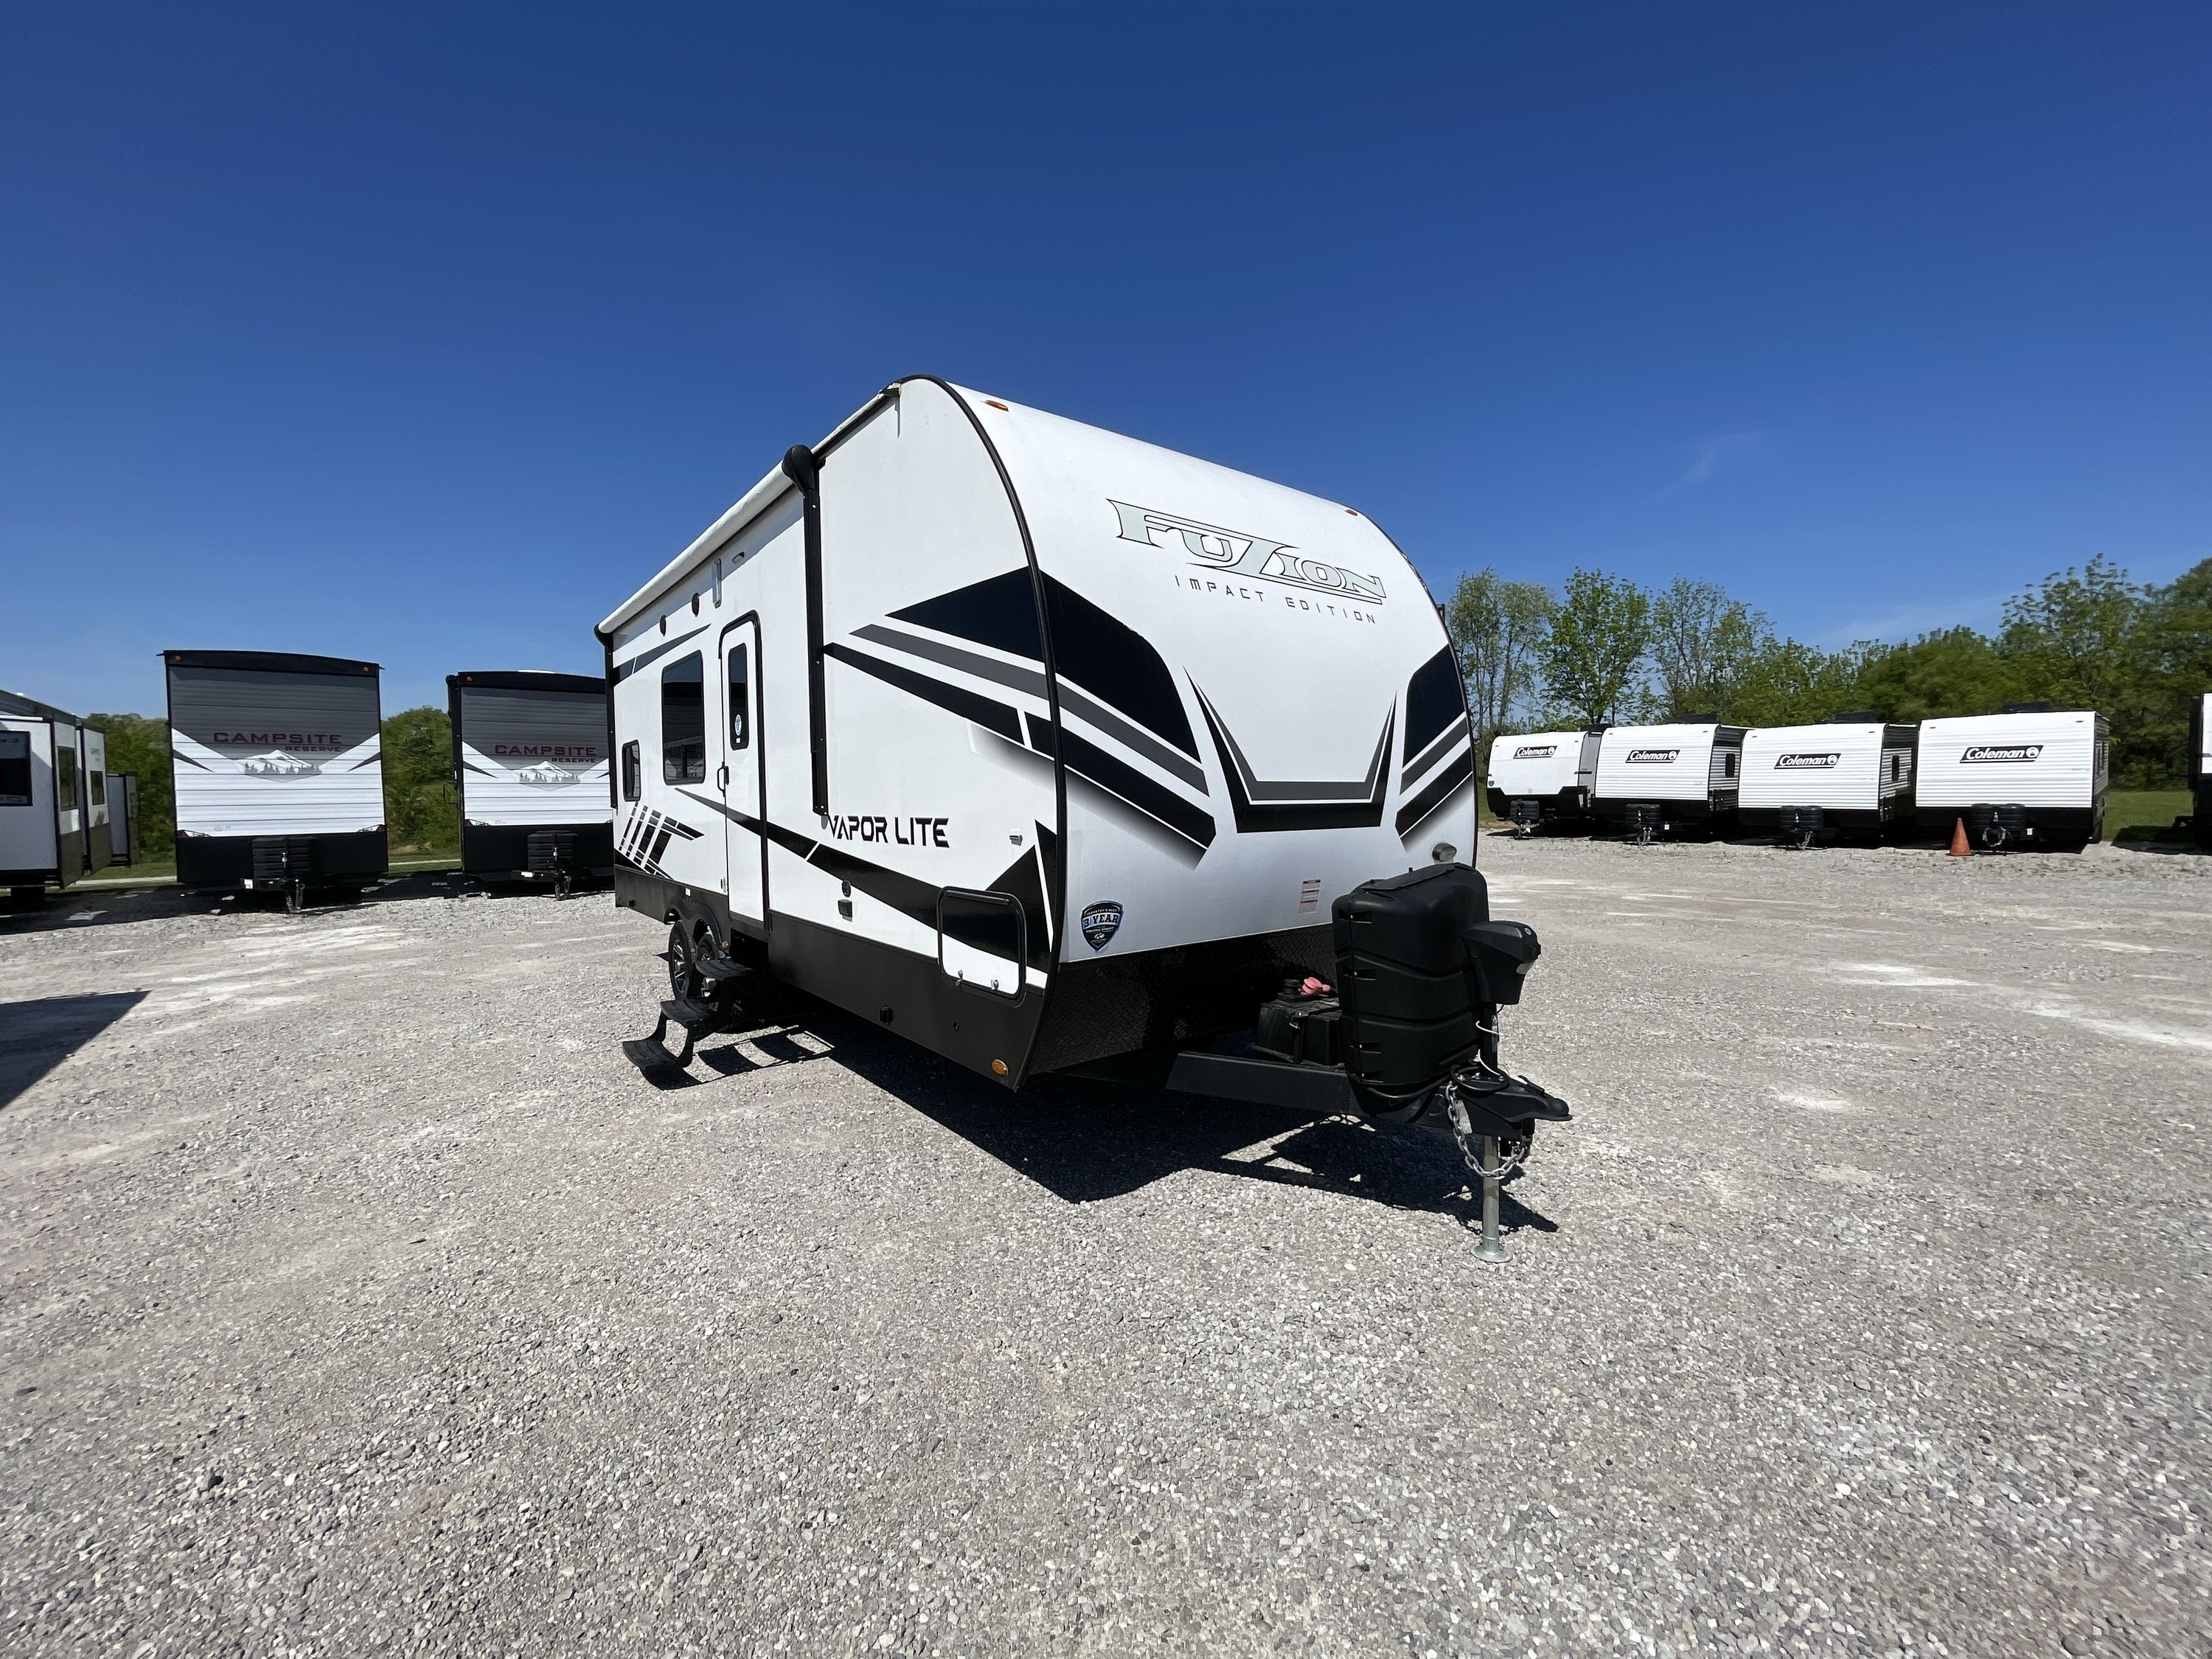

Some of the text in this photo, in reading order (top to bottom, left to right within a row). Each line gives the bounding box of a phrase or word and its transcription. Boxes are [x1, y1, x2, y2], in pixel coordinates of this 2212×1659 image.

[1175, 575, 1377, 625] IMPACT EDITION
[213, 732, 343, 745] CAMPSITE
[495, 745, 597, 757] CAMPSITE
[1516, 747, 1548, 757] Coleman
[1630, 751, 1669, 761] Coleman
[1966, 747, 2025, 760] Coleman
[1779, 754, 1826, 766] Coleman
[828, 815, 950, 849] VAPOR LITE
[1092, 914, 1119, 925] YEAR
